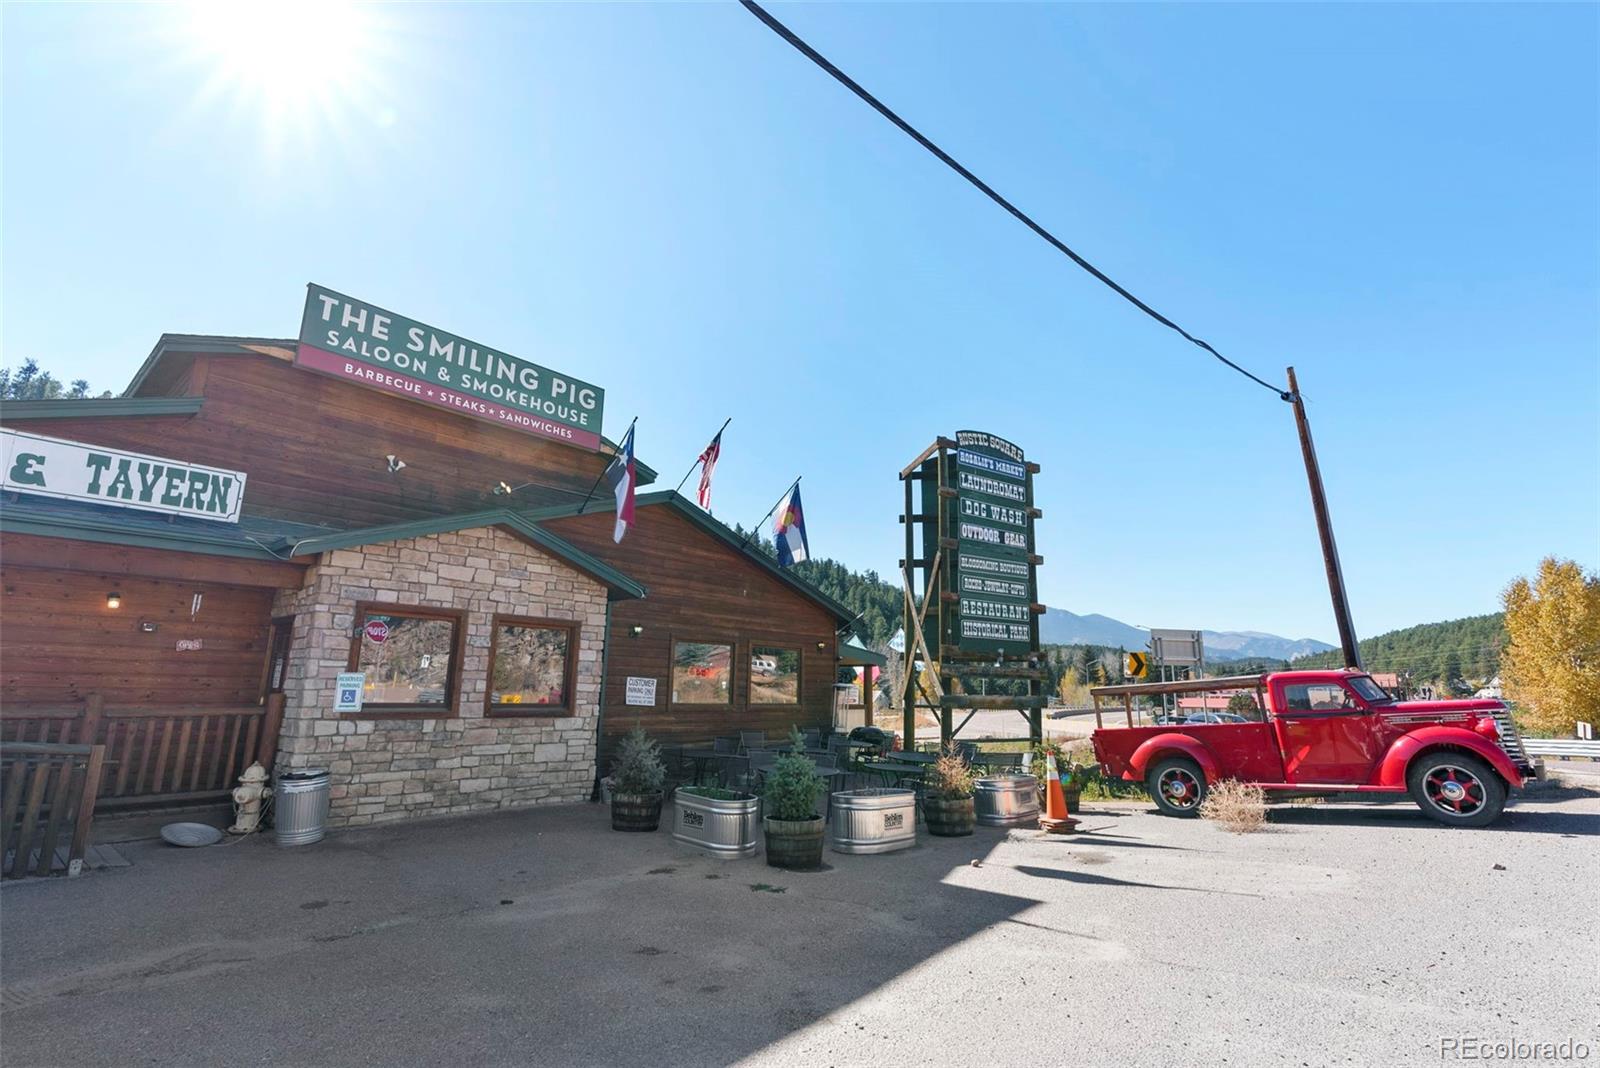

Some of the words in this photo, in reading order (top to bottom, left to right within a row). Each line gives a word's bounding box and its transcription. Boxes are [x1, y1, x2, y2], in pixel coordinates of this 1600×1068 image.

[319, 294, 391, 341] THE
[406, 327, 538, 390] SMILING
[551, 377, 596, 410] PIG
[326, 330, 427, 374] SALOON
[437, 366, 451, 382] &
[461, 374, 588, 425] SMOKEHOUSE
[344, 363, 421, 395] BARBECUE
[440, 392, 486, 414] STEAKS
[499, 410, 573, 439] SANDWICHES
[957, 432, 988, 446] RUSTIC
[990, 436, 1023, 463] SQUARE
[995, 461, 1023, 477] MARKET
[9, 453, 47, 487] &
[86, 453, 233, 514] TAVERN
[961, 473, 1024, 500] LAUNDROMAT
[965, 501, 987, 517] DOG
[991, 506, 1023, 524] WASH
[962, 524, 1000, 542] OUTDOOR
[1004, 532, 1026, 547] GEAR
[963, 600, 1028, 619] RESTAURANT
[963, 621, 1008, 638] HISTORICAL
[1010, 625, 1029, 639] PARK
[628, 679, 655, 688] CUSTOMER
